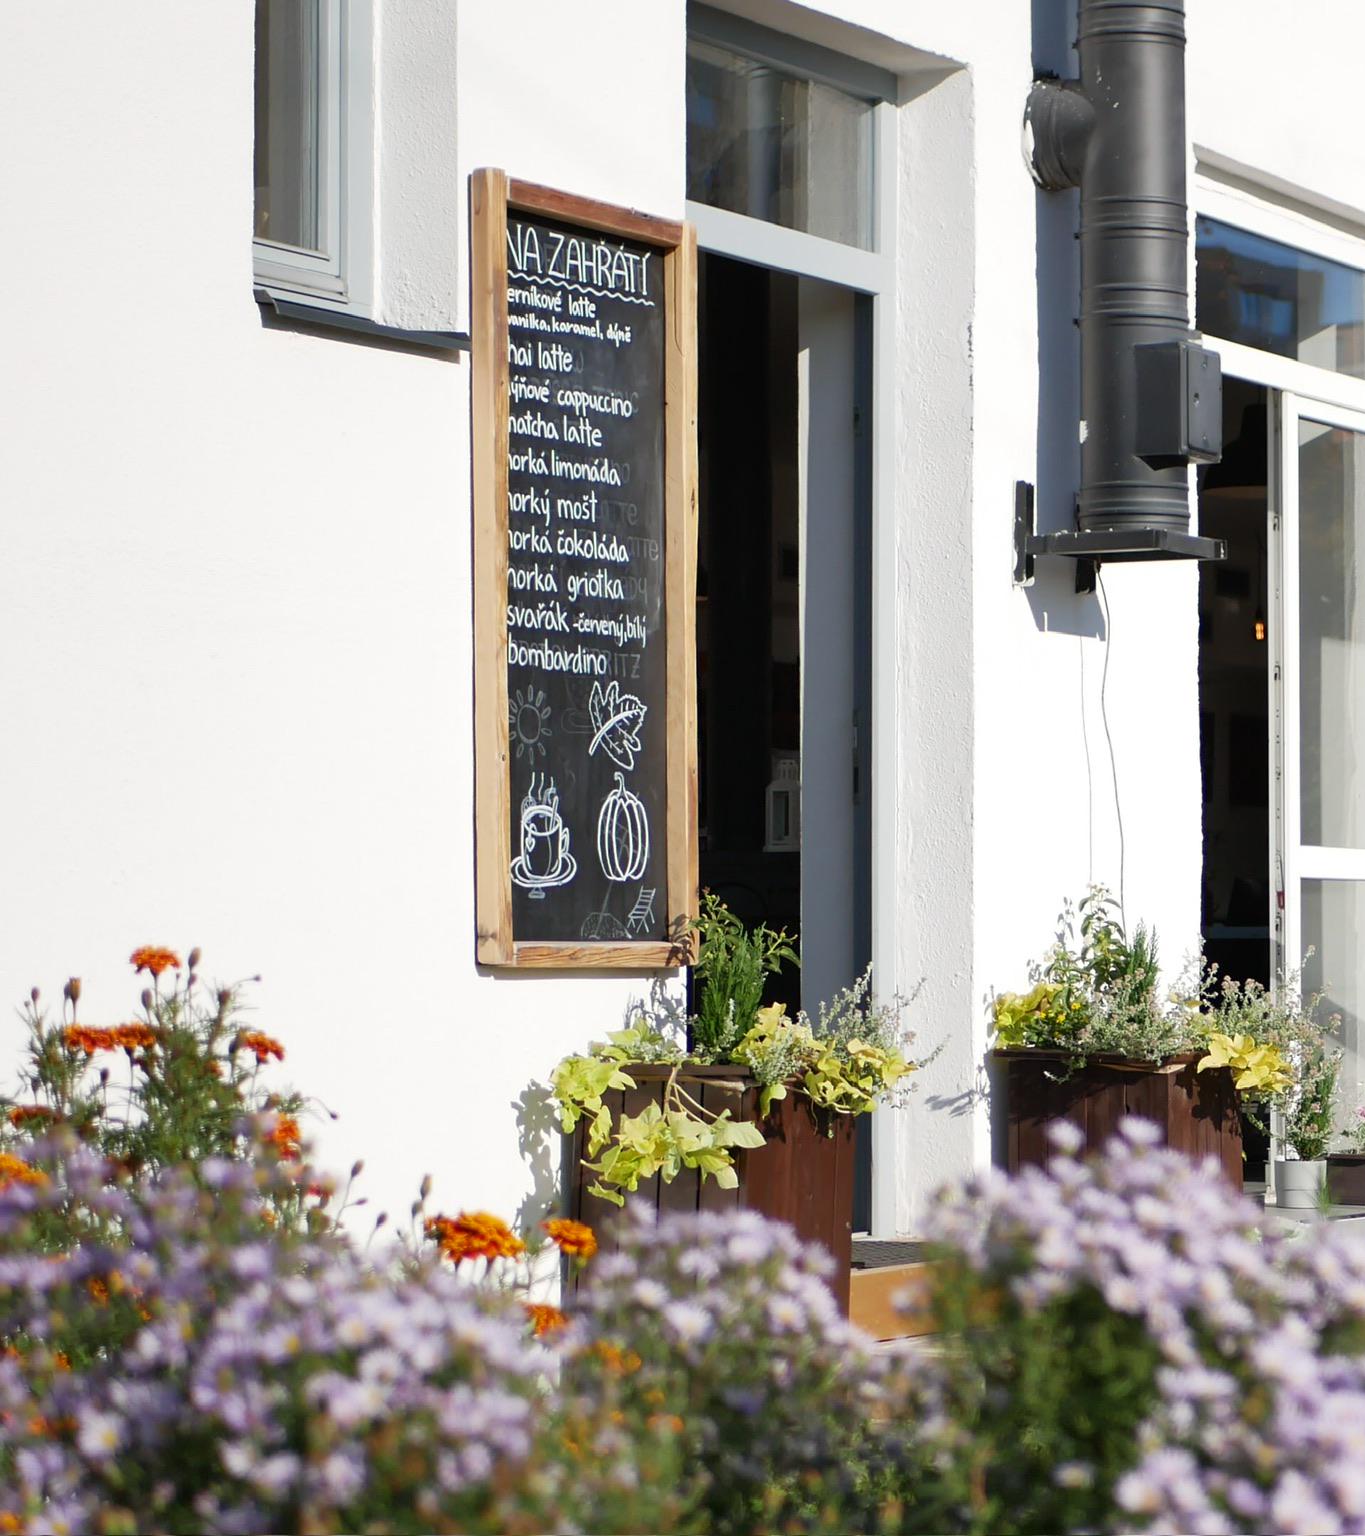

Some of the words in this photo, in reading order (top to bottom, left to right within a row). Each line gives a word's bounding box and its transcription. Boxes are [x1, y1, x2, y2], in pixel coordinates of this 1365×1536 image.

[548, 232, 651, 295] ZAHŘÁTÍ
[507, 285, 562, 312] erníkové
[568, 294, 596, 318] latte
[606, 322, 631, 347] dýně
[507, 334, 532, 367] hai
[538, 341, 573, 372] latte
[508, 375, 550, 403] ýňové
[557, 389, 633, 418] cappuccino
[563, 415, 602, 447] latte
[551, 449, 621, 486] limonáda
[557, 490, 598, 523] mošt
[557, 529, 629, 562] čokoláda
[567, 568, 625, 602] griotka
[507, 600, 570, 633] svařák
[508, 632, 607, 675] bombardino
